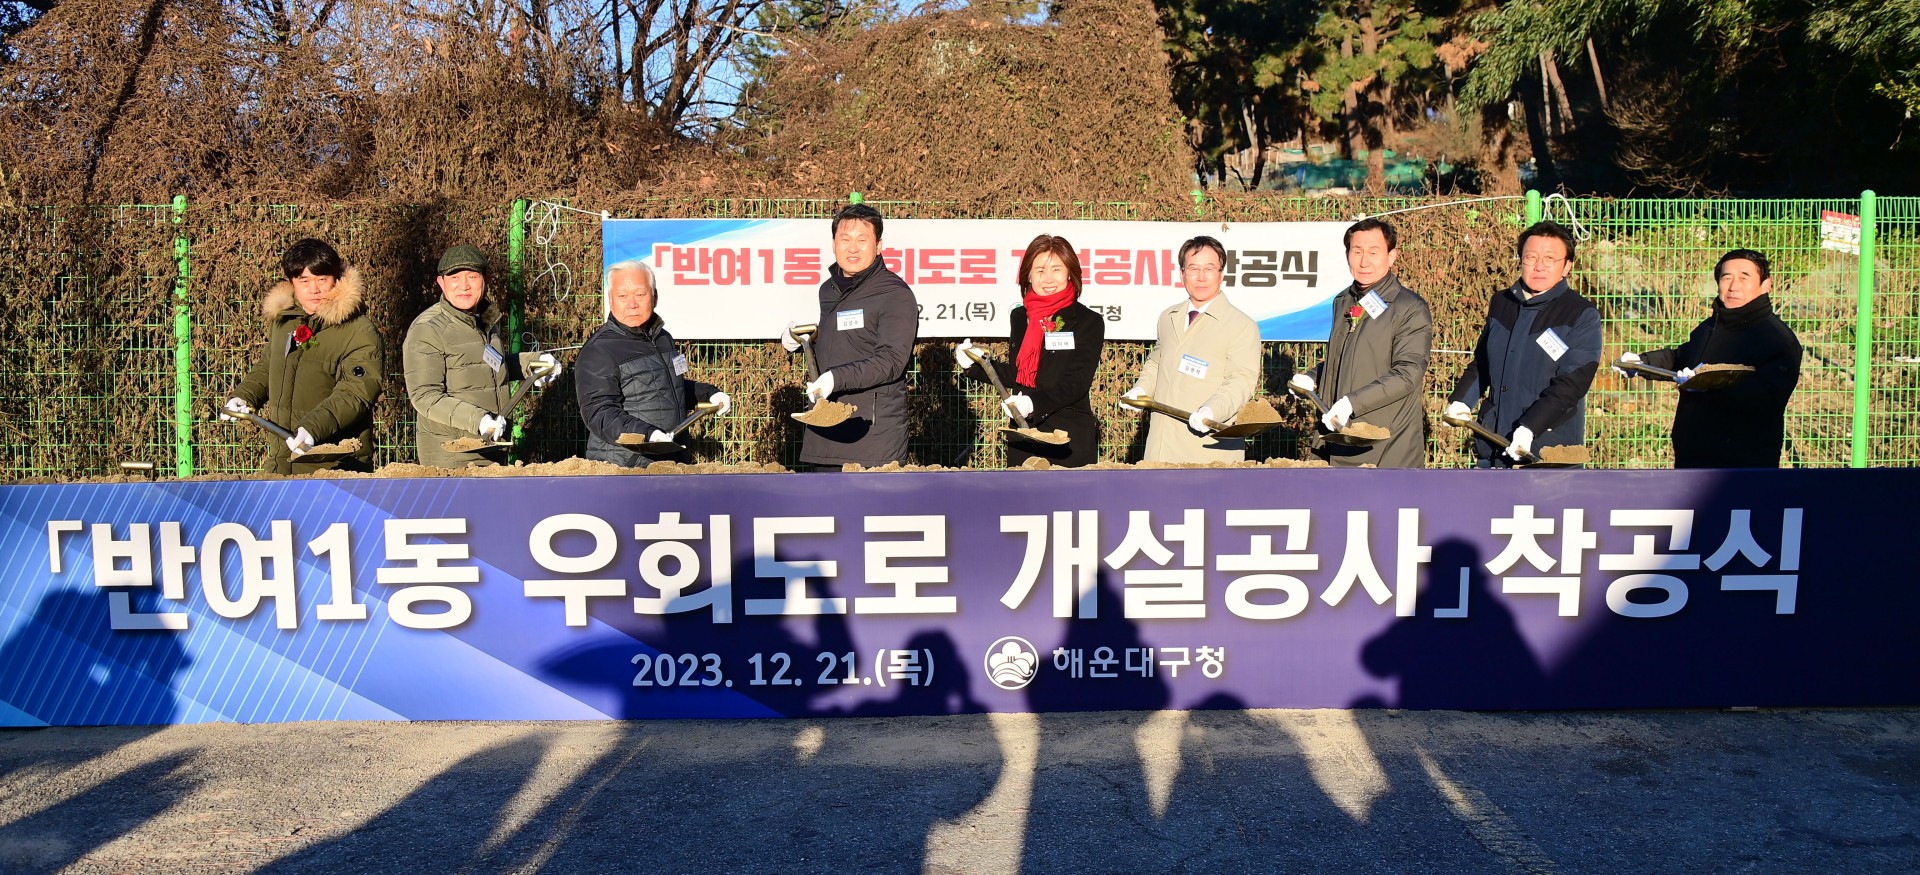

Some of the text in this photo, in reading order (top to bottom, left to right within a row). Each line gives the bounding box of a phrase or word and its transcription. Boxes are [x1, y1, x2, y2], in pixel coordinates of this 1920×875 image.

[655, 245, 821, 286] 「반여1동
[881, 247, 997, 285] 회도로
[1223, 249, 1319, 288] 공식
[936, 302, 996, 322] 21.(목)
[47, 518, 480, 630] 「반여1동
[523, 511, 957, 624] 우회도로
[630, 648, 935, 688] 2023. 12. 21.(목)
[1052, 645, 1225, 681] 해운대구청
